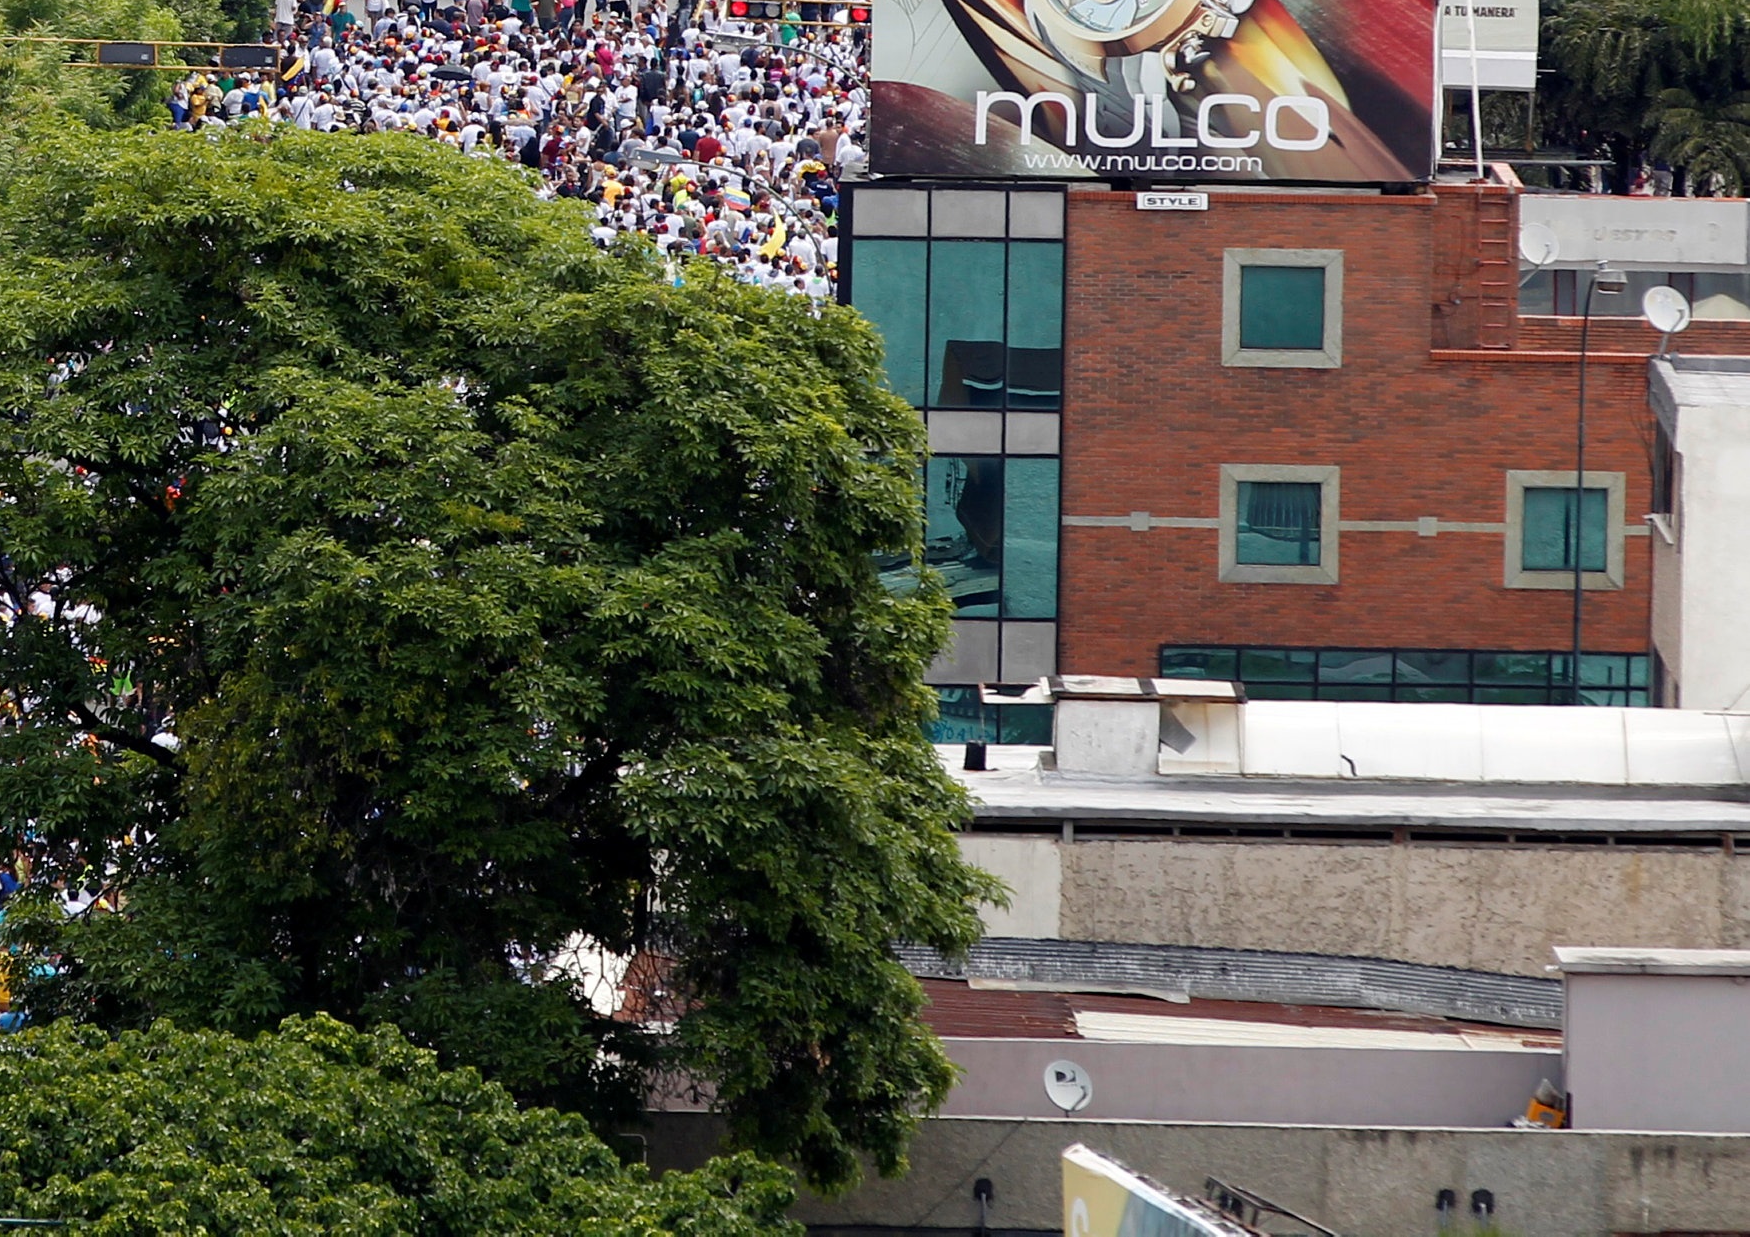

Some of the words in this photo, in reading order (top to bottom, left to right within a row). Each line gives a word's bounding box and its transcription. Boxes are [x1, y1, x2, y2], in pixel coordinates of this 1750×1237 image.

[1444, 5, 1451, 16] A
[1454, 5, 1468, 17] TU
[1472, 6, 1515, 18] MANERA
[1147, 197, 1199, 207] STYLE
